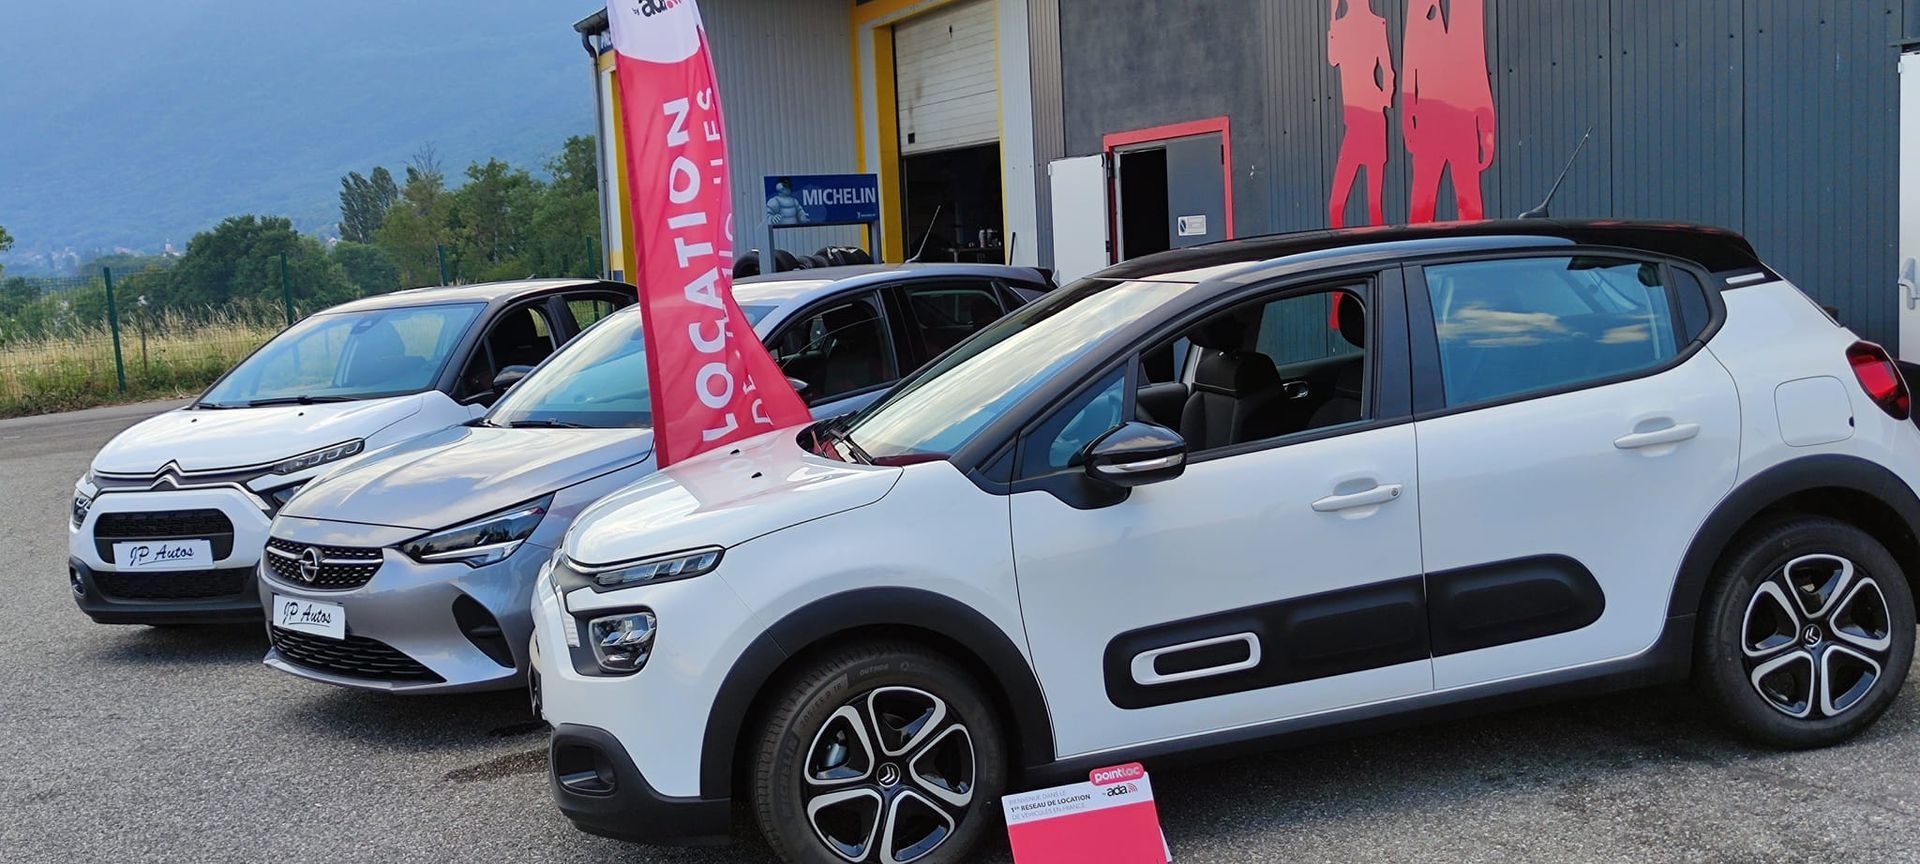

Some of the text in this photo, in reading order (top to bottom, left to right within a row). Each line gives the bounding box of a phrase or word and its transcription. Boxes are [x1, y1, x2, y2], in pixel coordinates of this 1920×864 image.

[802, 188, 876, 206] MICHELIN
[663, 97, 739, 442] LOCATION
[154, 544, 194, 560] Autos
[301, 604, 332, 624] Autos
[1094, 766, 1140, 783] pointloc
[1106, 784, 1128, 797] ada
[1047, 799, 1057, 807] DE
[1057, 794, 1091, 805] LOCATION
